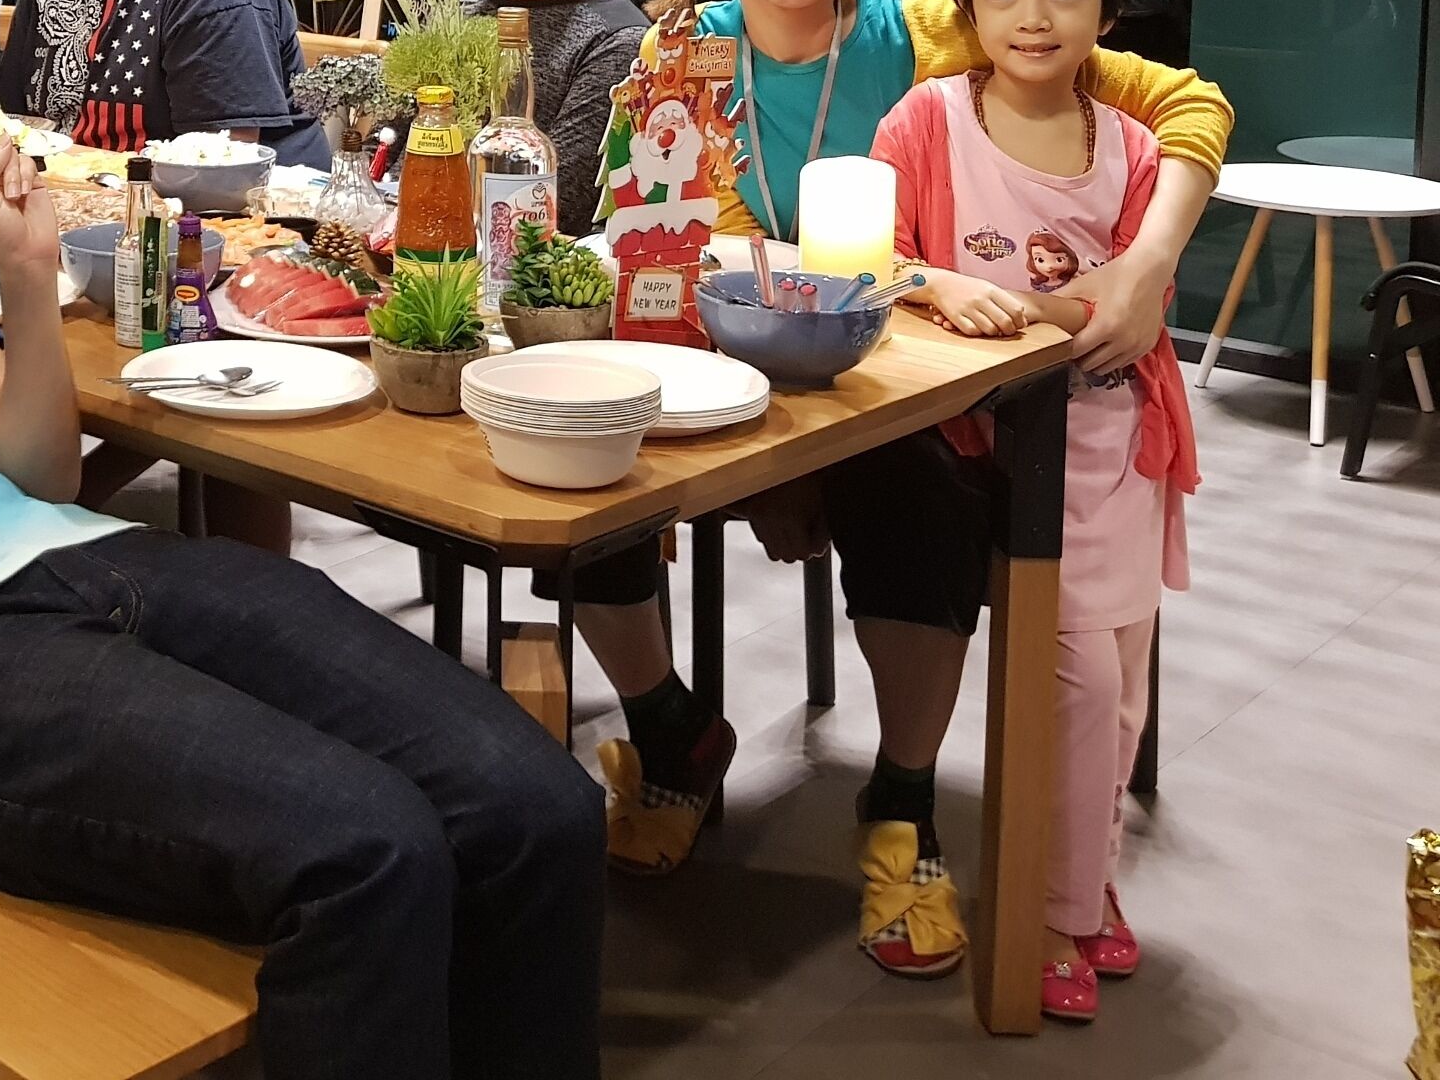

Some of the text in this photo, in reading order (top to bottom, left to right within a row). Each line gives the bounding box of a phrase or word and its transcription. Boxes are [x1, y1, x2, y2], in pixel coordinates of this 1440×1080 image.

[700, 44, 730, 59] MERRY
[966, 234, 1006, 254] Sofia
[642, 280, 672, 294] HAPPY
[633, 297, 677, 311] NEW YEAR
